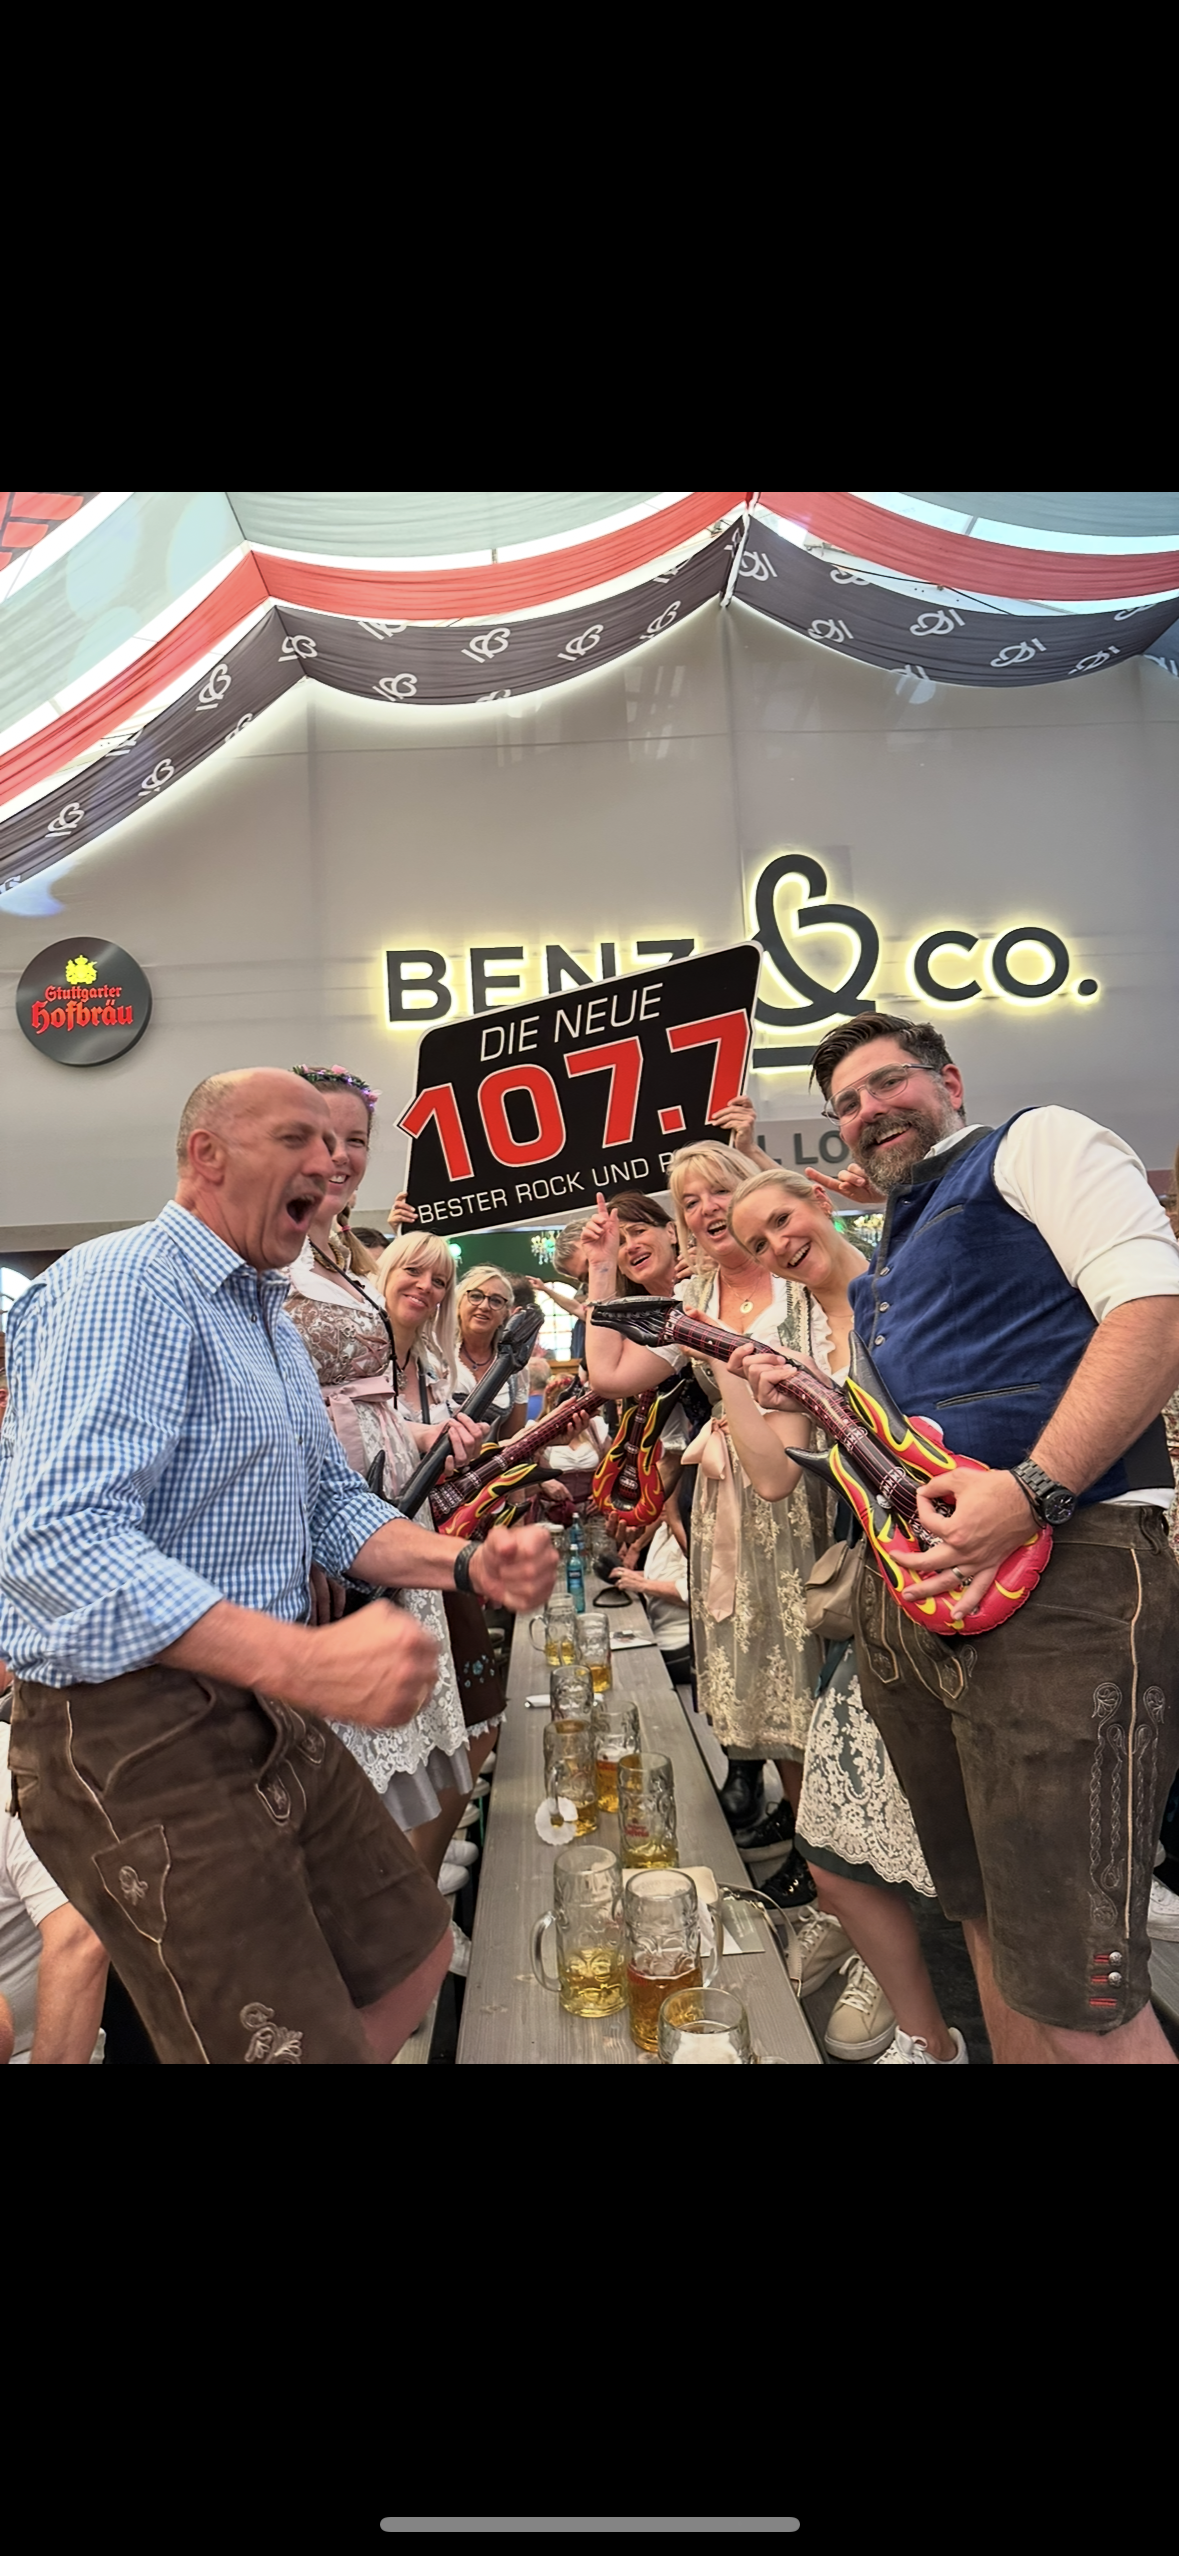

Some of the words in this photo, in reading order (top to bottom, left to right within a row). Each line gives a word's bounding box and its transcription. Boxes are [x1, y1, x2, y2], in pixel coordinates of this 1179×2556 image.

[44, 984, 122, 1003] Stuttgarter
[914, 926, 1099, 1002] CO.
[31, 998, 134, 1035] Hofbräu
[480, 1015, 540, 1062] DIE
[554, 982, 664, 1043] NEUE
[398, 1007, 752, 1183] 107.7
[417, 1187, 509, 1225] BESTER
[514, 1171, 586, 1204] ROCK
[591, 1156, 650, 1188] UND
